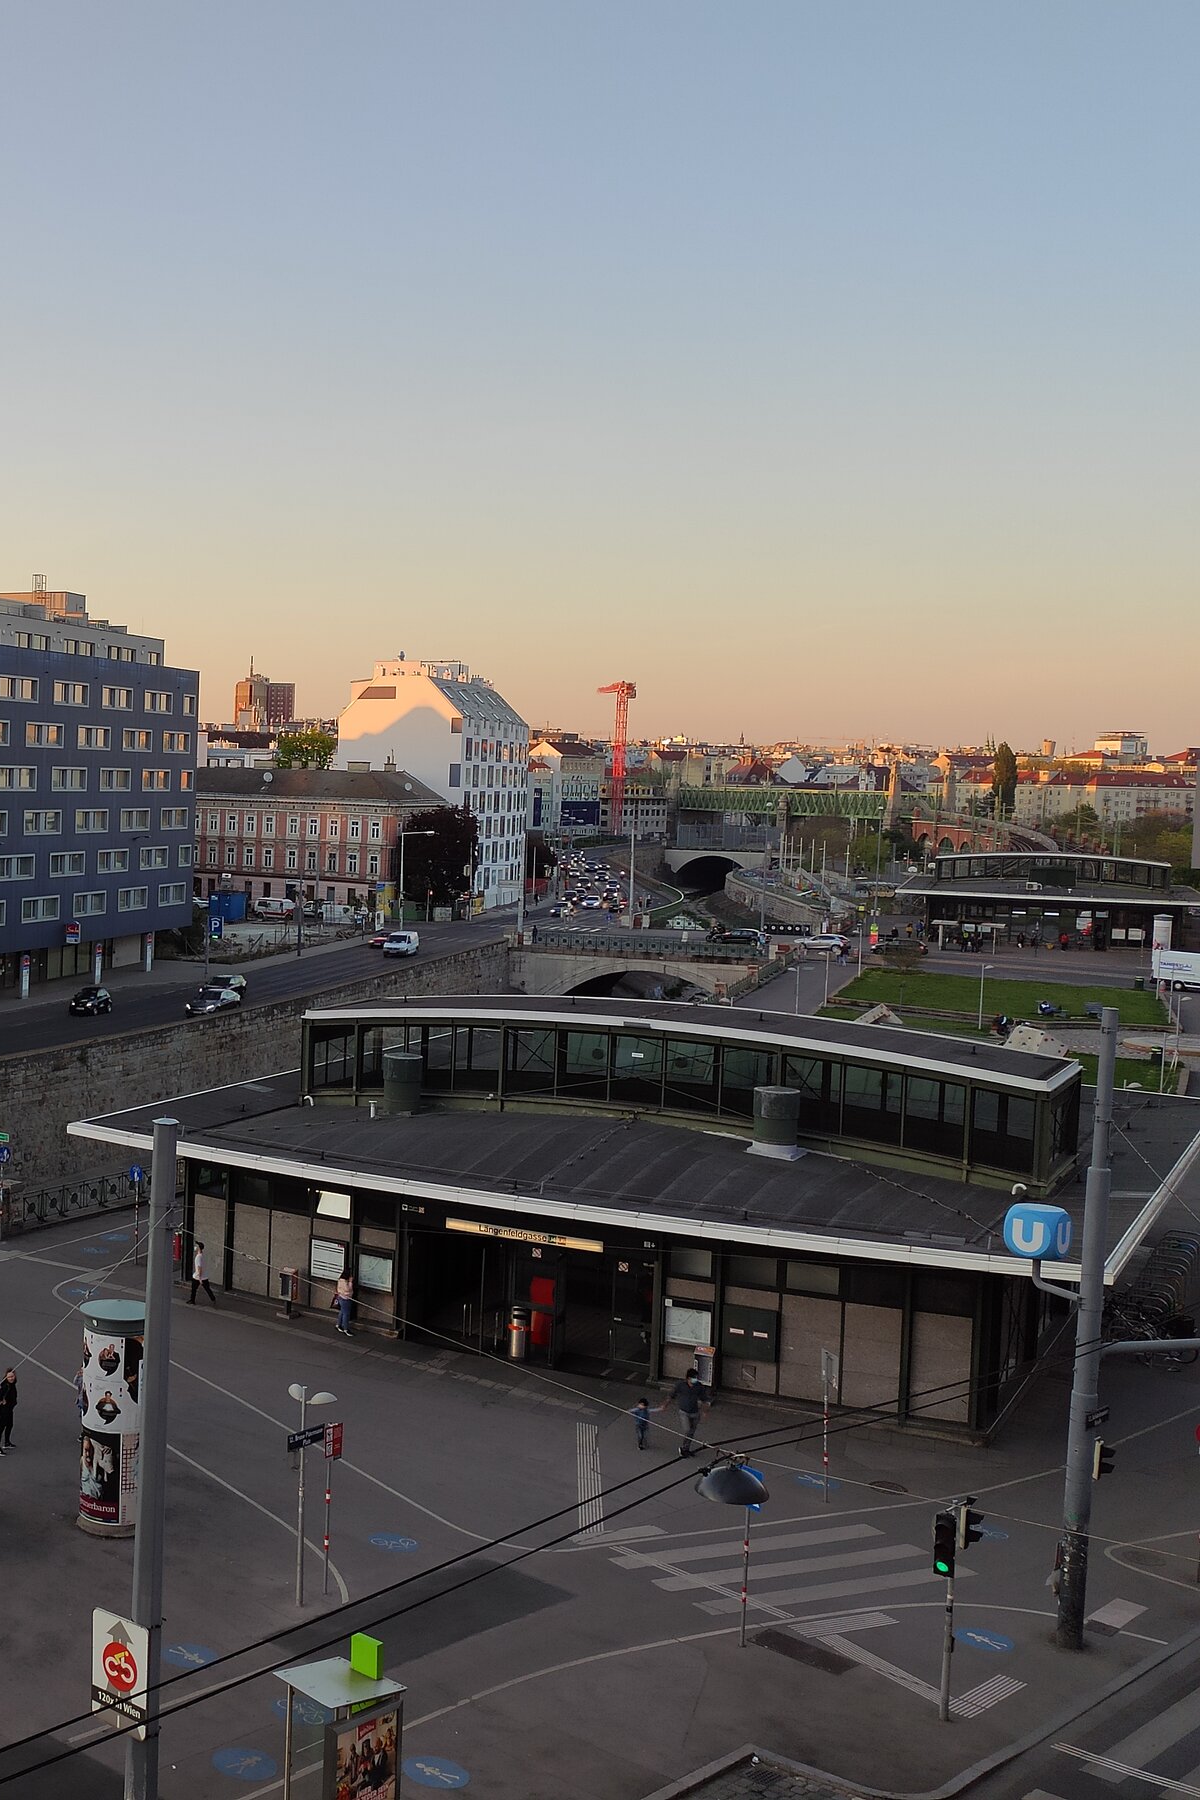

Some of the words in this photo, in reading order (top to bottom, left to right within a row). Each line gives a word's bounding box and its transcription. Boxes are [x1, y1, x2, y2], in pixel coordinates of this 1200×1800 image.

[211, 920, 221, 931] P
[478, 1223, 547, 1244] Längenfeldgasse
[1012, 1218, 1044, 1253] U
[1057, 1222, 1071, 1254] U
[122, 1701, 141, 1719] Wien
